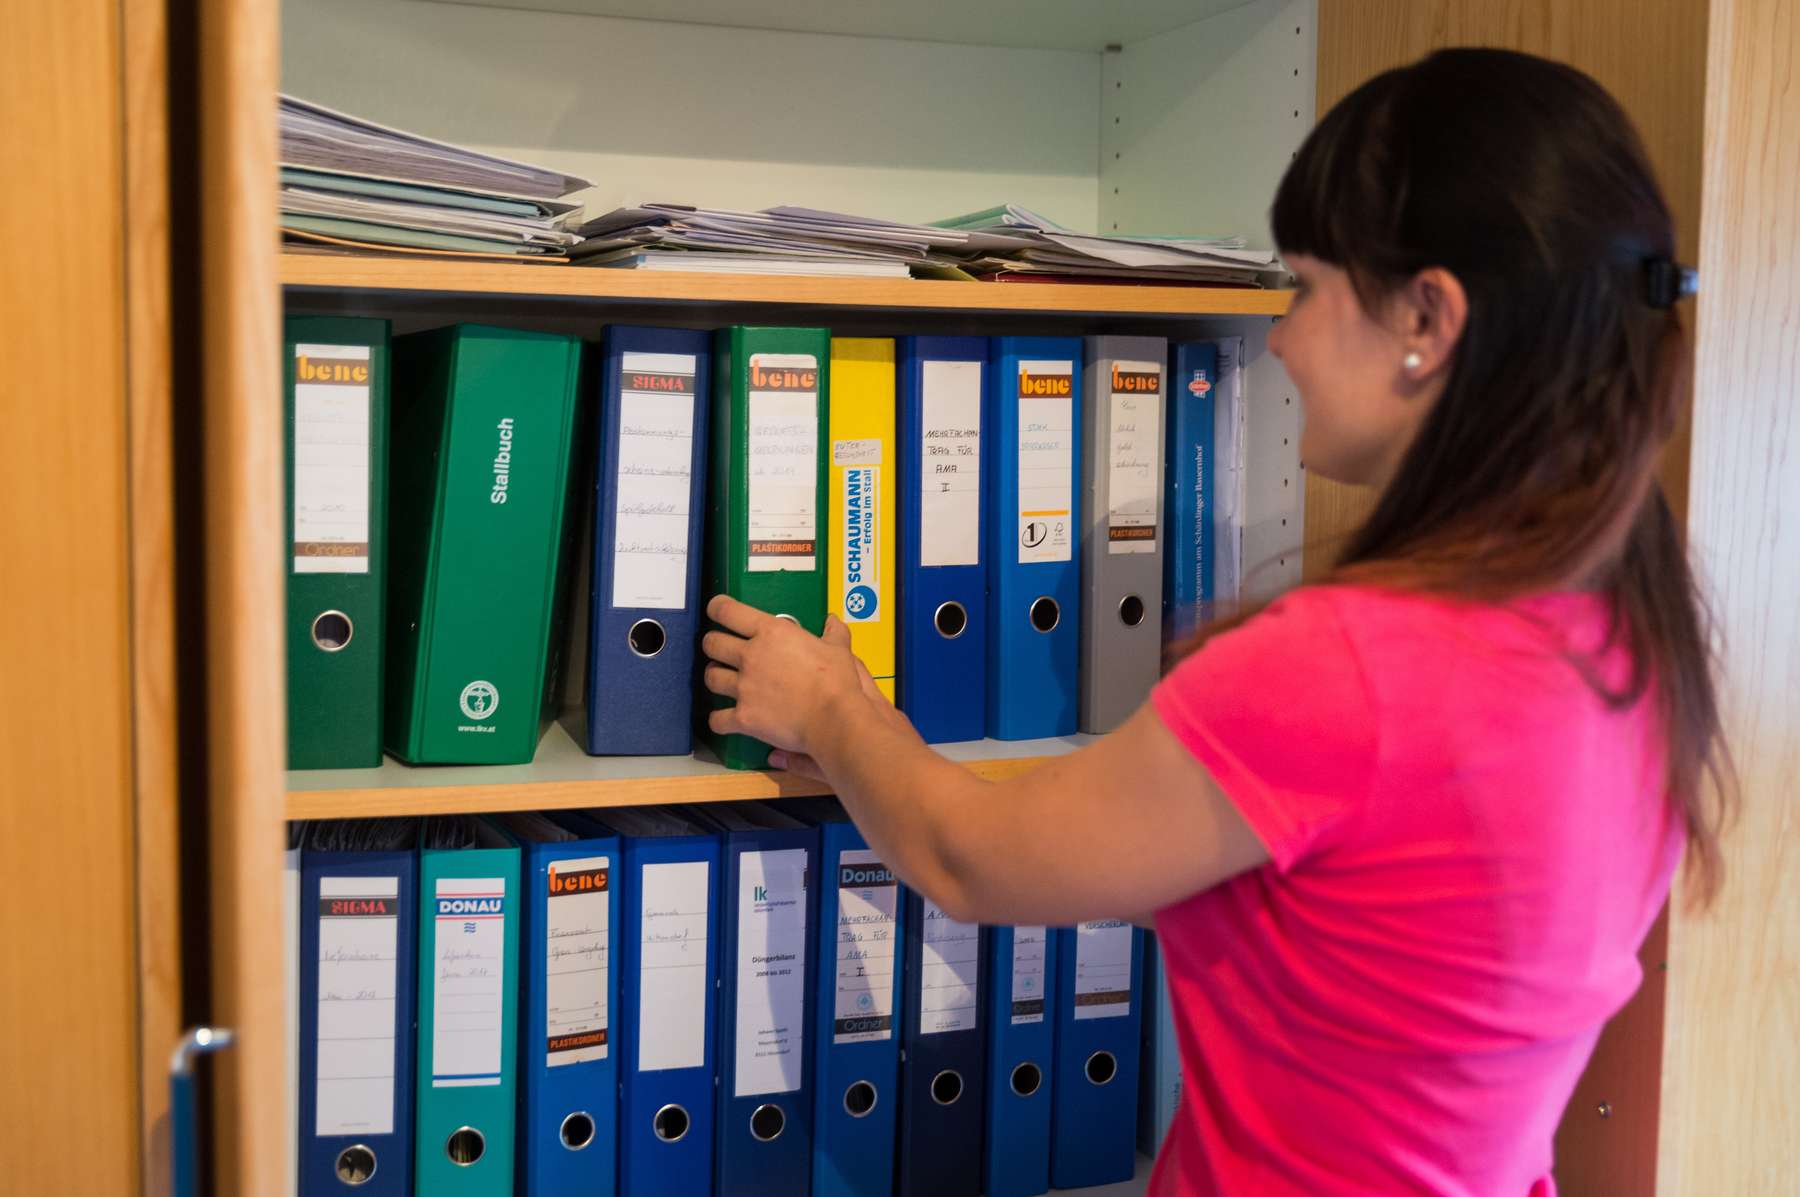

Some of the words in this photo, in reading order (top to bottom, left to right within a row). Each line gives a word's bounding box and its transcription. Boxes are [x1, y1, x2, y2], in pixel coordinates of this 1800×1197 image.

[299, 354, 369, 381] bene
[752, 359, 815, 388] bene
[632, 375, 685, 392] SIGMA
[1021, 368, 1070, 394] bene
[1112, 365, 1159, 391] bene
[490, 417, 514, 505] Stallbuch
[936, 464, 958, 474] AMA
[1192, 444, 1204, 491] Bauernhof
[864, 470, 872, 492] Stall
[848, 470, 861, 583] SCHAUMANN
[864, 513, 873, 544] Erfolg
[304, 543, 360, 557] Ordner
[751, 543, 812, 553] PLASTIKORDNER
[549, 866, 608, 893] bene
[842, 867, 895, 883] Donau
[754, 886, 768, 902] lk
[331, 902, 386, 914] SIGMA
[439, 900, 502, 913] DONAU
[752, 954, 796, 964] Düngerbilanz
[844, 1019, 882, 1032] Ordner
[550, 1034, 606, 1049] PLASTIKORDNER
